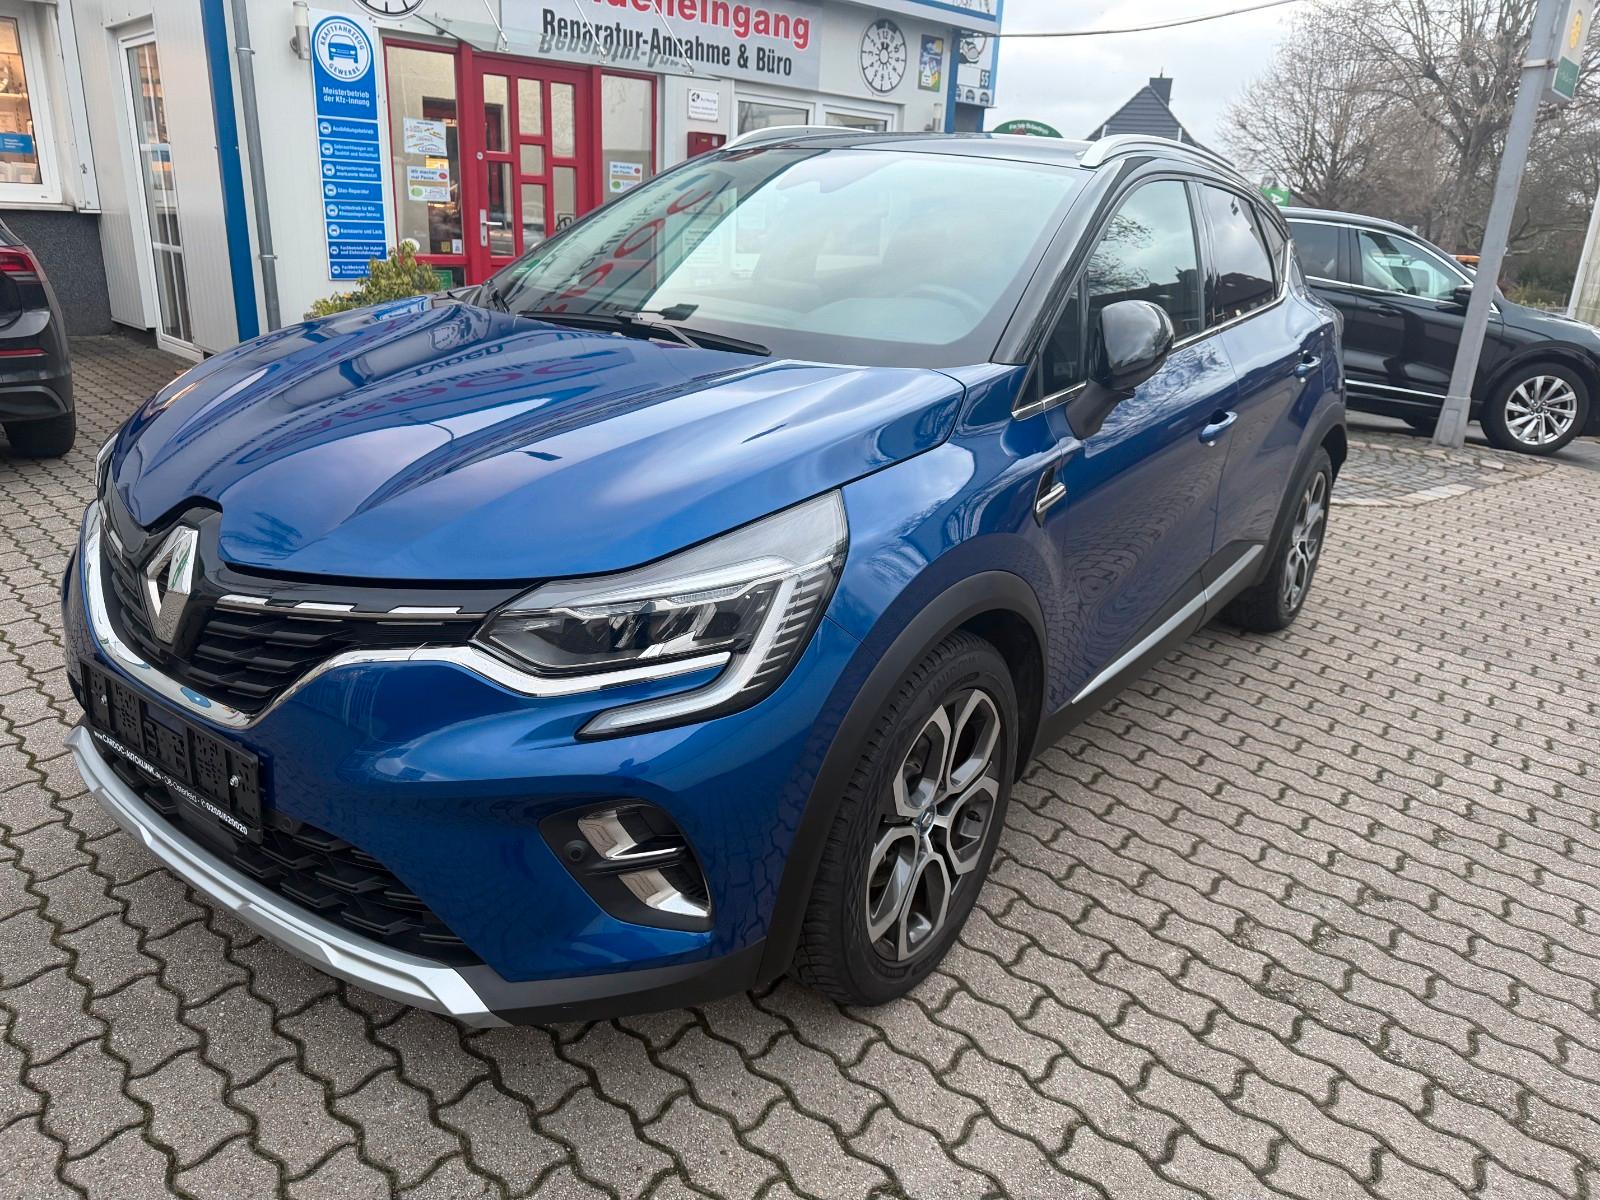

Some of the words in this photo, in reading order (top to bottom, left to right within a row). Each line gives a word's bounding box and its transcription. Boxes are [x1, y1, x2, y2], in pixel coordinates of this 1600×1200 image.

[738, 49, 749, 69] &
[756, 46, 793, 76] Büro
[322, 86, 370, 99] Meisterbetrieb
[323, 94, 335, 102] der
